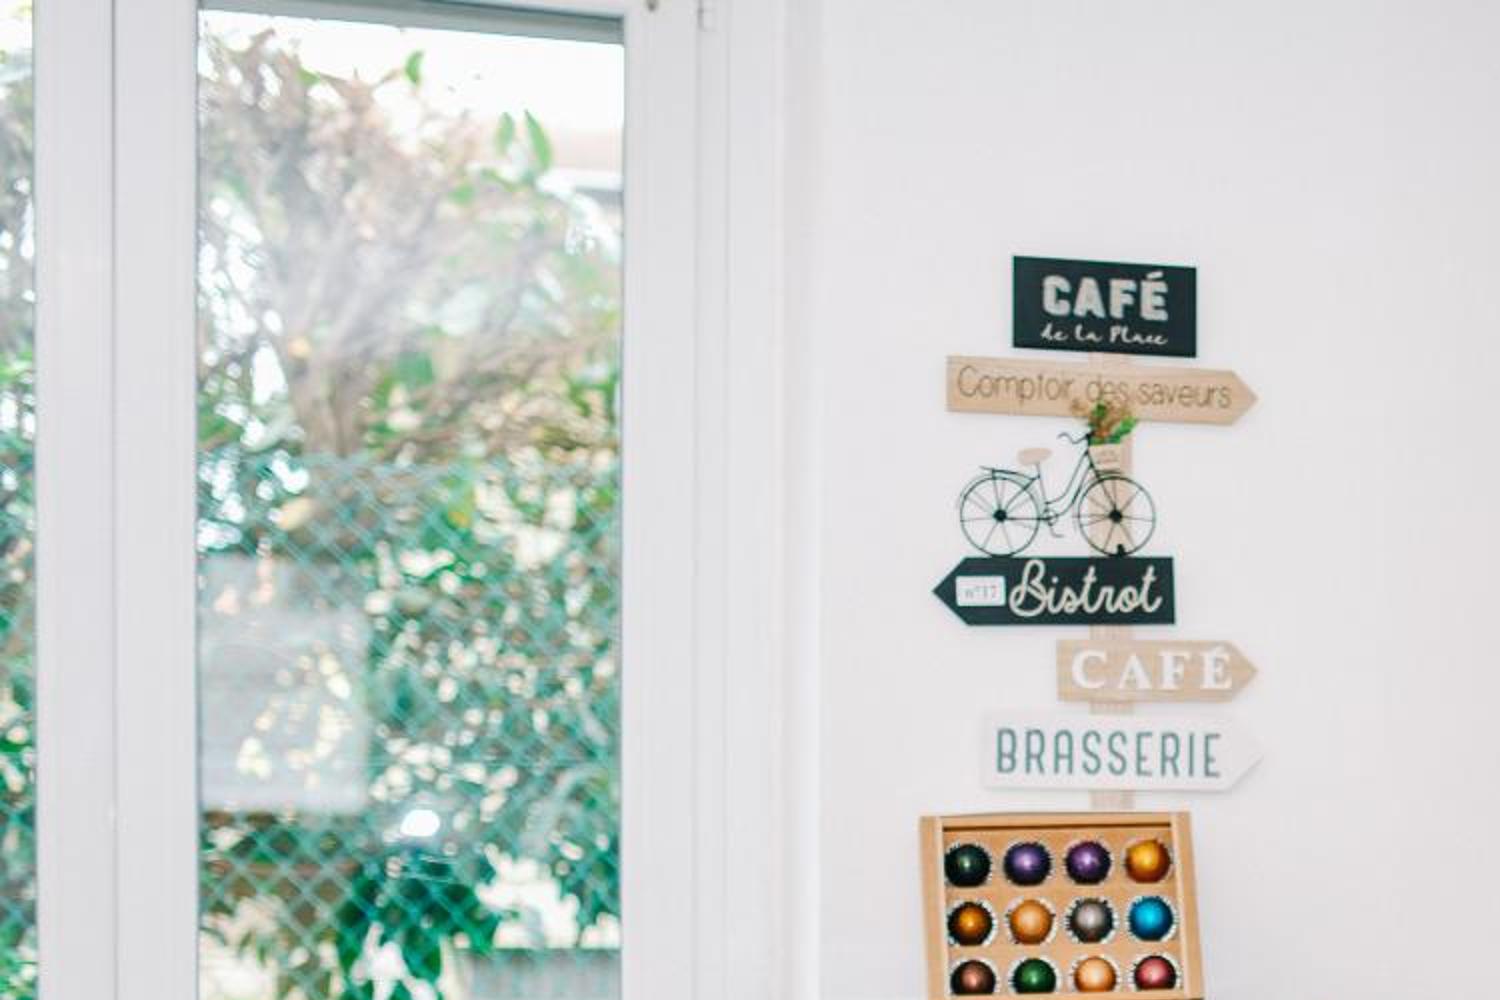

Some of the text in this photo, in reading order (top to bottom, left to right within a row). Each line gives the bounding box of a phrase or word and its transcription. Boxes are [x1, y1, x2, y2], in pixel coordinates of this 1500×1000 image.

[1042, 270, 1169, 321] CAFÉ
[1041, 322, 1168, 345] de la Place
[1086, 373, 1130, 403] des
[1136, 382, 1232, 409] saveurs
[1009, 558, 1163, 617] Bistrot
[1071, 645, 1234, 691] CAFÉ
[996, 727, 1223, 779] BRASSERIE
